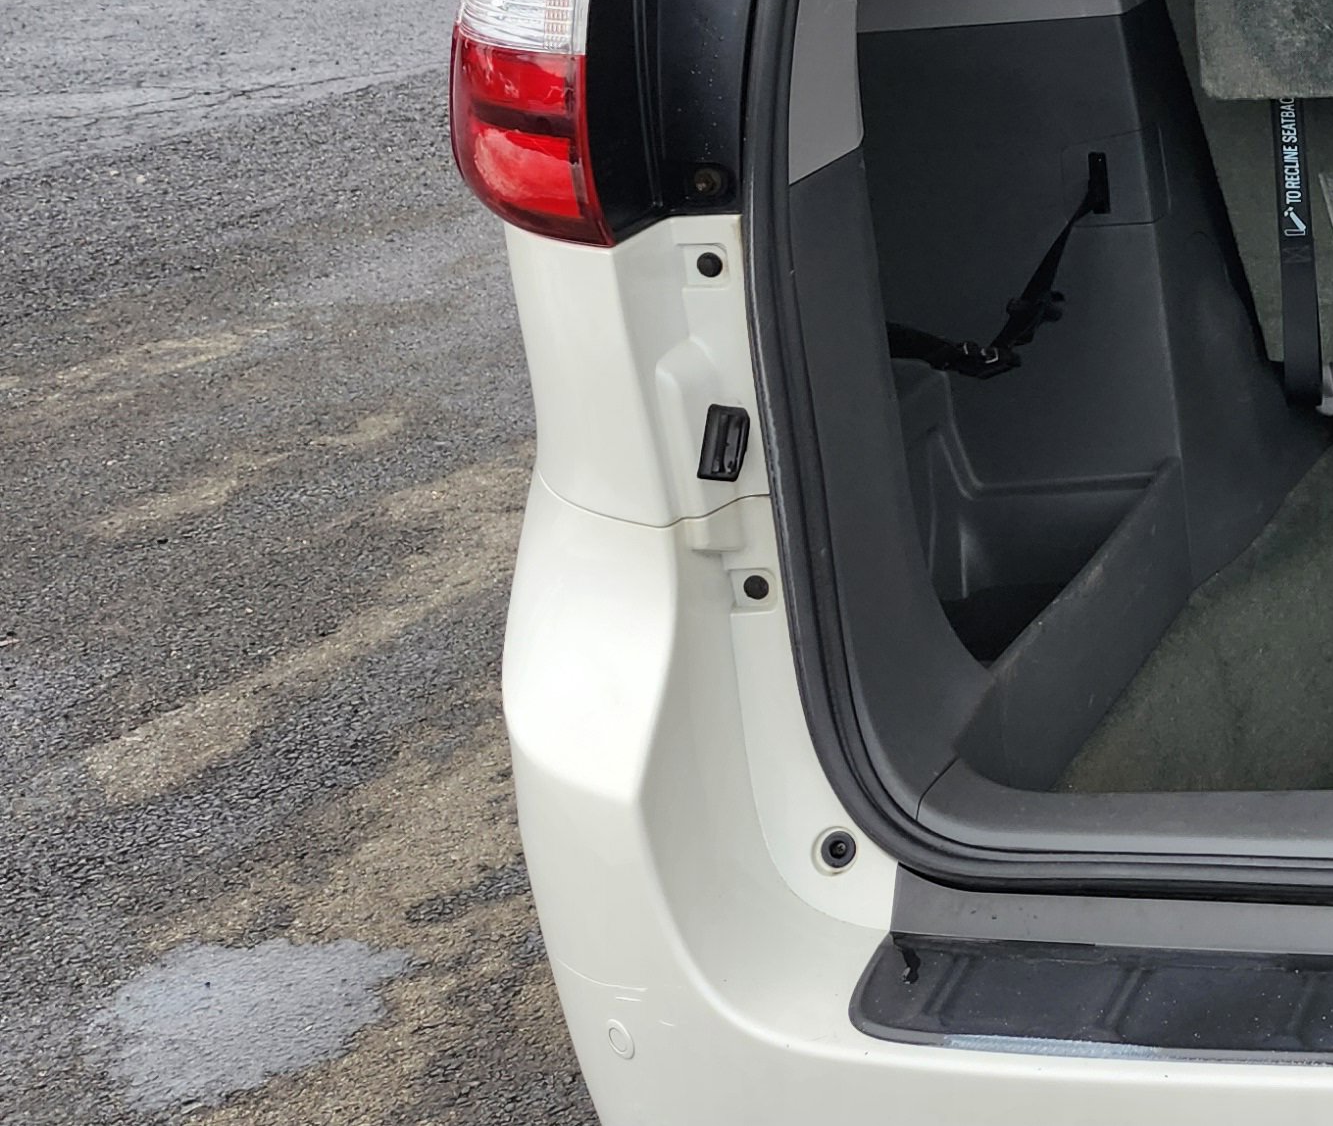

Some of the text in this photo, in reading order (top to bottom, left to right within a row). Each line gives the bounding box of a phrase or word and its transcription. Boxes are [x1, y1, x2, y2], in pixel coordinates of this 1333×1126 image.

[1280, 97, 1302, 205] TO RECLINE SEATBAC
